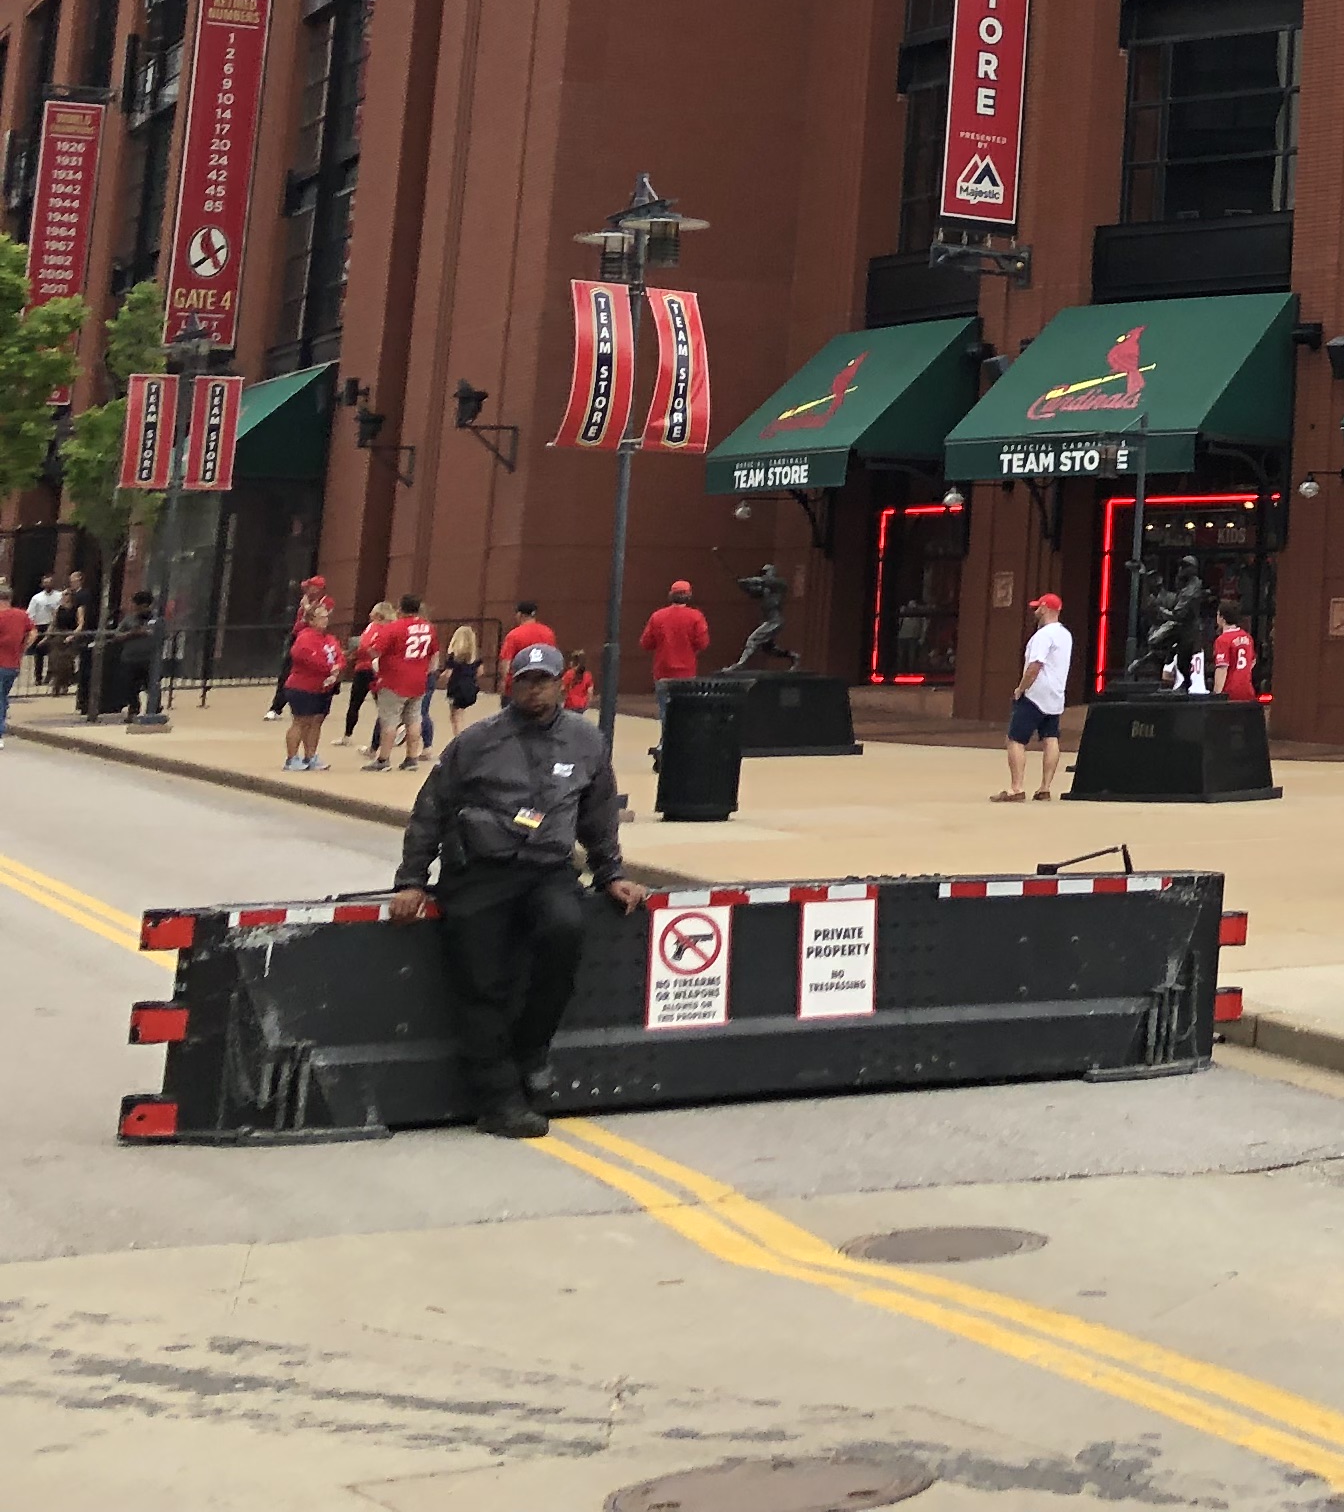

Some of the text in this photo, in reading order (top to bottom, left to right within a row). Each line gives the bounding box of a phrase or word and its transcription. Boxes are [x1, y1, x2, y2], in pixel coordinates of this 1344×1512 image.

[208, 7, 260, 24] NUMBERS
[228, 32, 235, 44] 1
[225, 48, 236, 59] 2
[223, 63, 234, 75] 6
[222, 78, 233, 90] 9
[217, 93, 234, 105] 10
[215, 108, 233, 120] 14
[214, 123, 231, 136] 17
[210, 138, 231, 151] 20
[959, 131, 1007, 145] PRESENTED
[208, 154, 229, 166] 24
[207, 169, 228, 182] 42
[205, 184, 226, 197] 45
[959, 185, 1001, 201] Majestic
[203, 199, 223, 213] 85
[174, 287, 232, 311] GATE 4
[587, 297, 612, 438] TEAM STORE
[671, 302, 688, 438] TEAM STORE
[141, 384, 158, 480] TEAM STORE
[204, 386, 223, 481] TEAM STORE
[1000, 449, 1128, 474] TEAM STOE
[734, 464, 809, 489] TEAM STORE
[1217, 528, 1247, 544] KIDS
[404, 634, 432, 660] 27
[1236, 648, 1247, 670] 6
[814, 926, 864, 942] PRIVATE
[806, 942, 870, 959] PROPERTY
[831, 969, 844, 979] NO
[656, 976, 721, 989] NO FIREARMS
[809, 979, 866, 993] TRESPASSING
[673, 988, 720, 1000] WEAPONS
